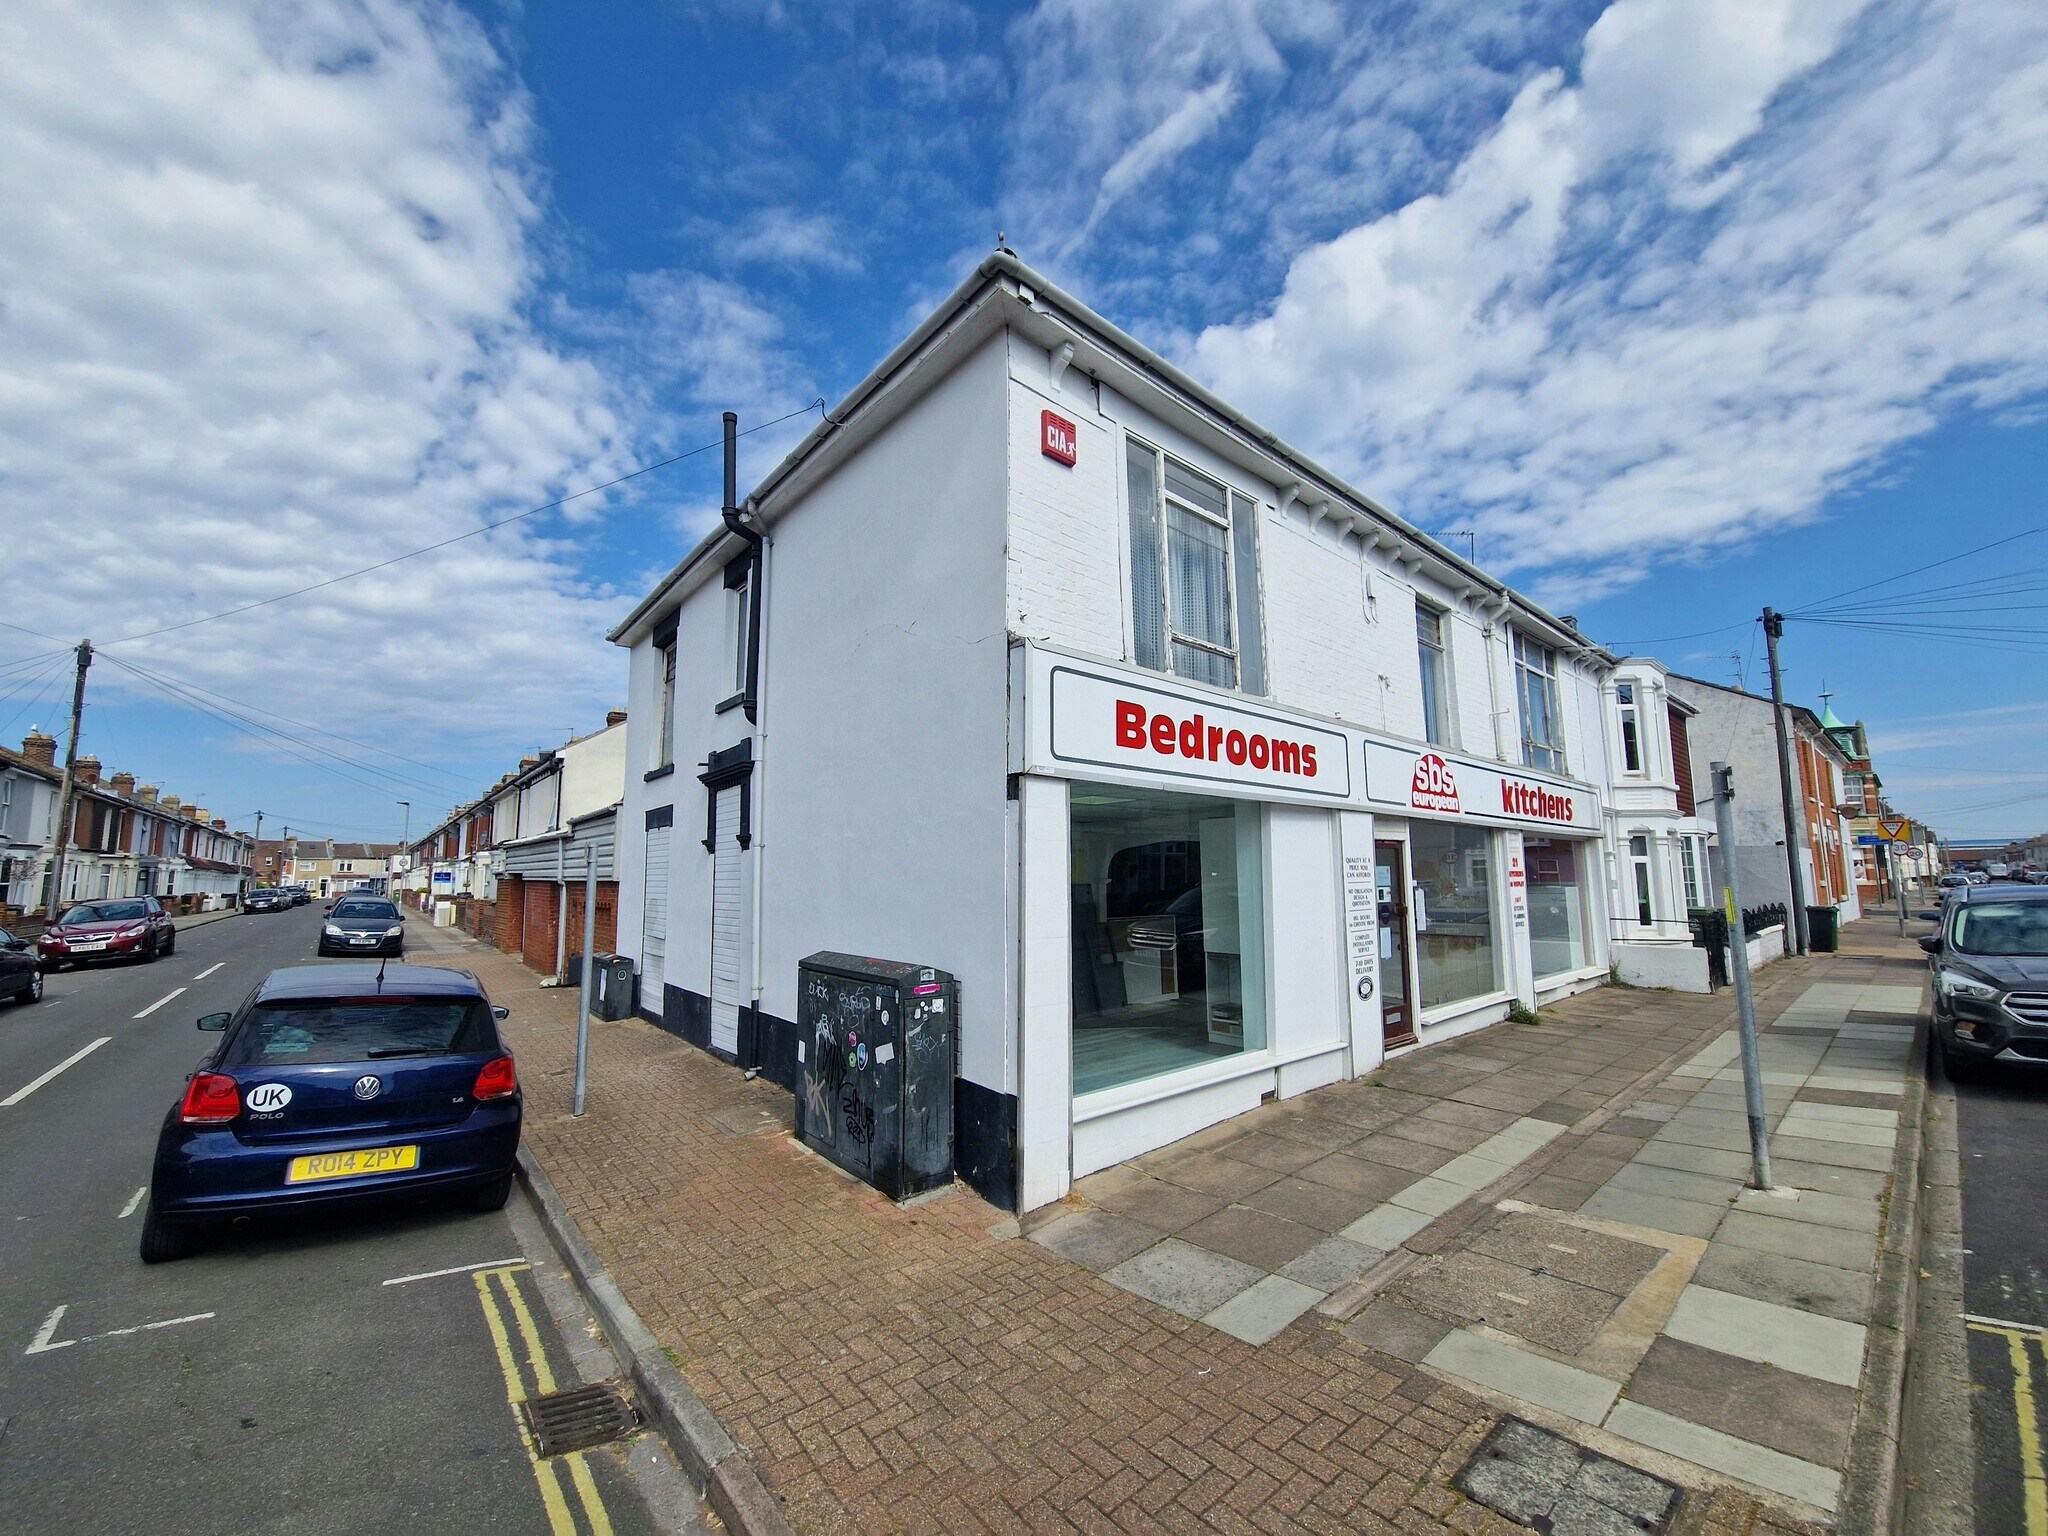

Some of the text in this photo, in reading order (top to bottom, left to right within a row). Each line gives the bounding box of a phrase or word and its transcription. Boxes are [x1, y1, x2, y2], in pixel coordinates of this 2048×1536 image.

[1115, 699, 1318, 778] Bedrooms
[1415, 755, 1455, 795] sbs
[1412, 790, 1459, 811] european
[1500, 778, 1574, 822] kitchens
[1356, 966, 1373, 974] DELIVERY
[252, 1088, 287, 1107] UK
[250, 1112, 284, 1121] POLO
[307, 1148, 404, 1175] RO14 ZPY
